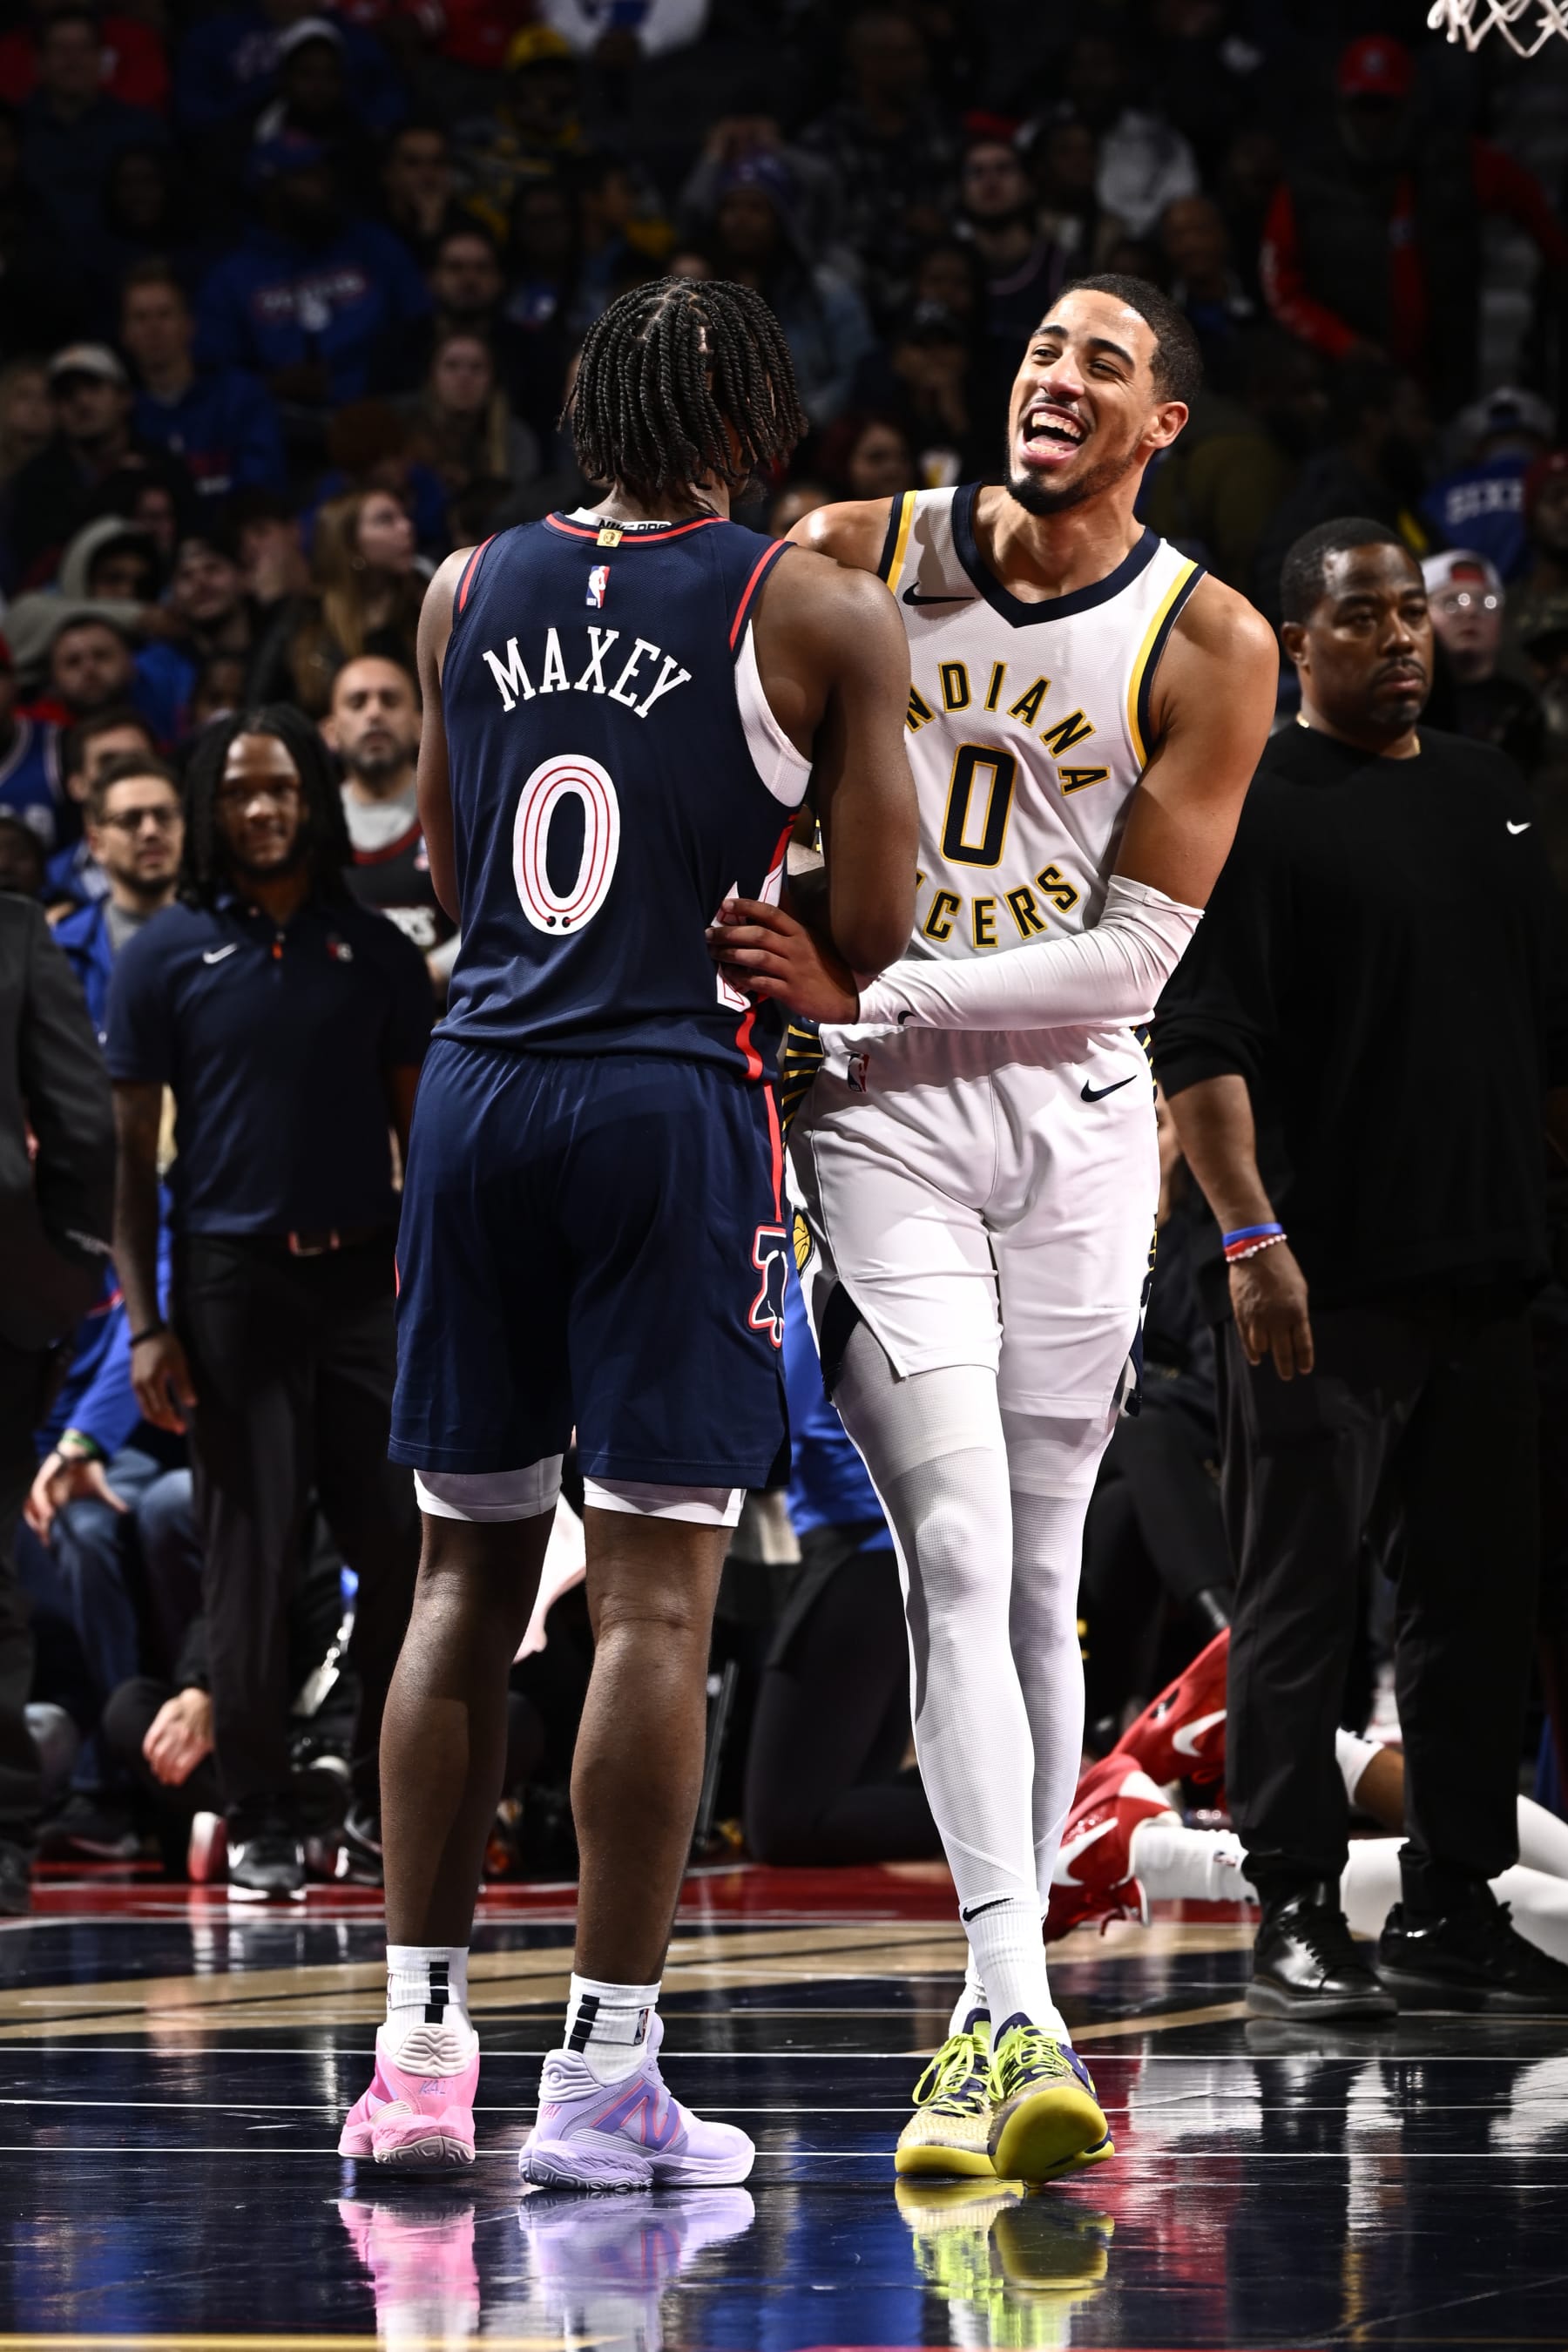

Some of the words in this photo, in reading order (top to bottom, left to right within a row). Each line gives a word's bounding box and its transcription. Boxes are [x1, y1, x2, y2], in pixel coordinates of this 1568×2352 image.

[483, 626, 692, 718] MAXEY
[905, 660, 1111, 796] NDIANA
[512, 754, 620, 936] 0
[940, 742, 1017, 869] 0
[916, 864, 1079, 949] CERS
